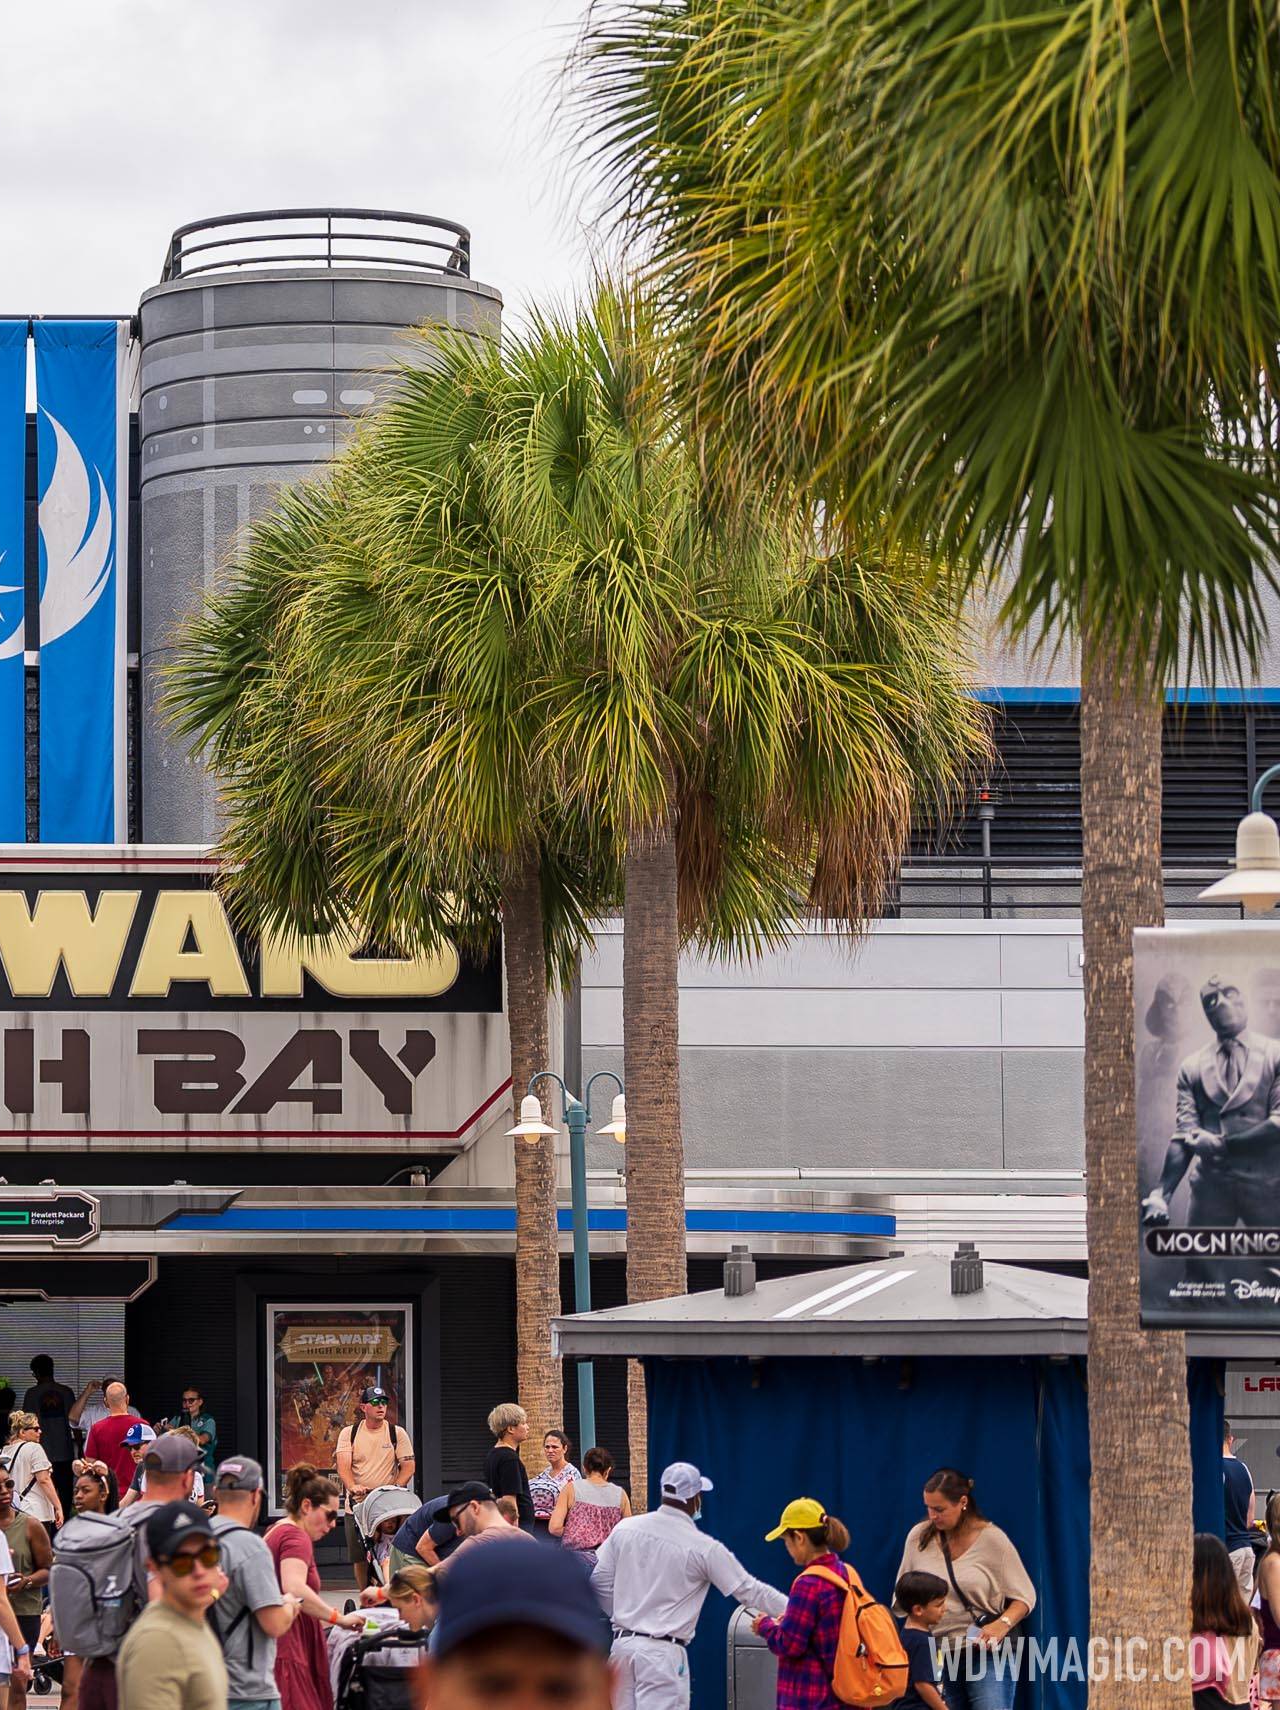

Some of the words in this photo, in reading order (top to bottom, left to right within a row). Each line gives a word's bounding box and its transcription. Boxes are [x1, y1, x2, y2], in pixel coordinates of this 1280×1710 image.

[137, 1029, 436, 1114] BAY
[1230, 1232, 1280, 1255] KNIG
[295, 1334, 339, 1345] STAR
[339, 1334, 383, 1345] WARS
[306, 1346, 333, 1355] HIGH
[335, 1347, 382, 1355] REPUBLIC
[1244, 1377, 1280, 1392] LA
